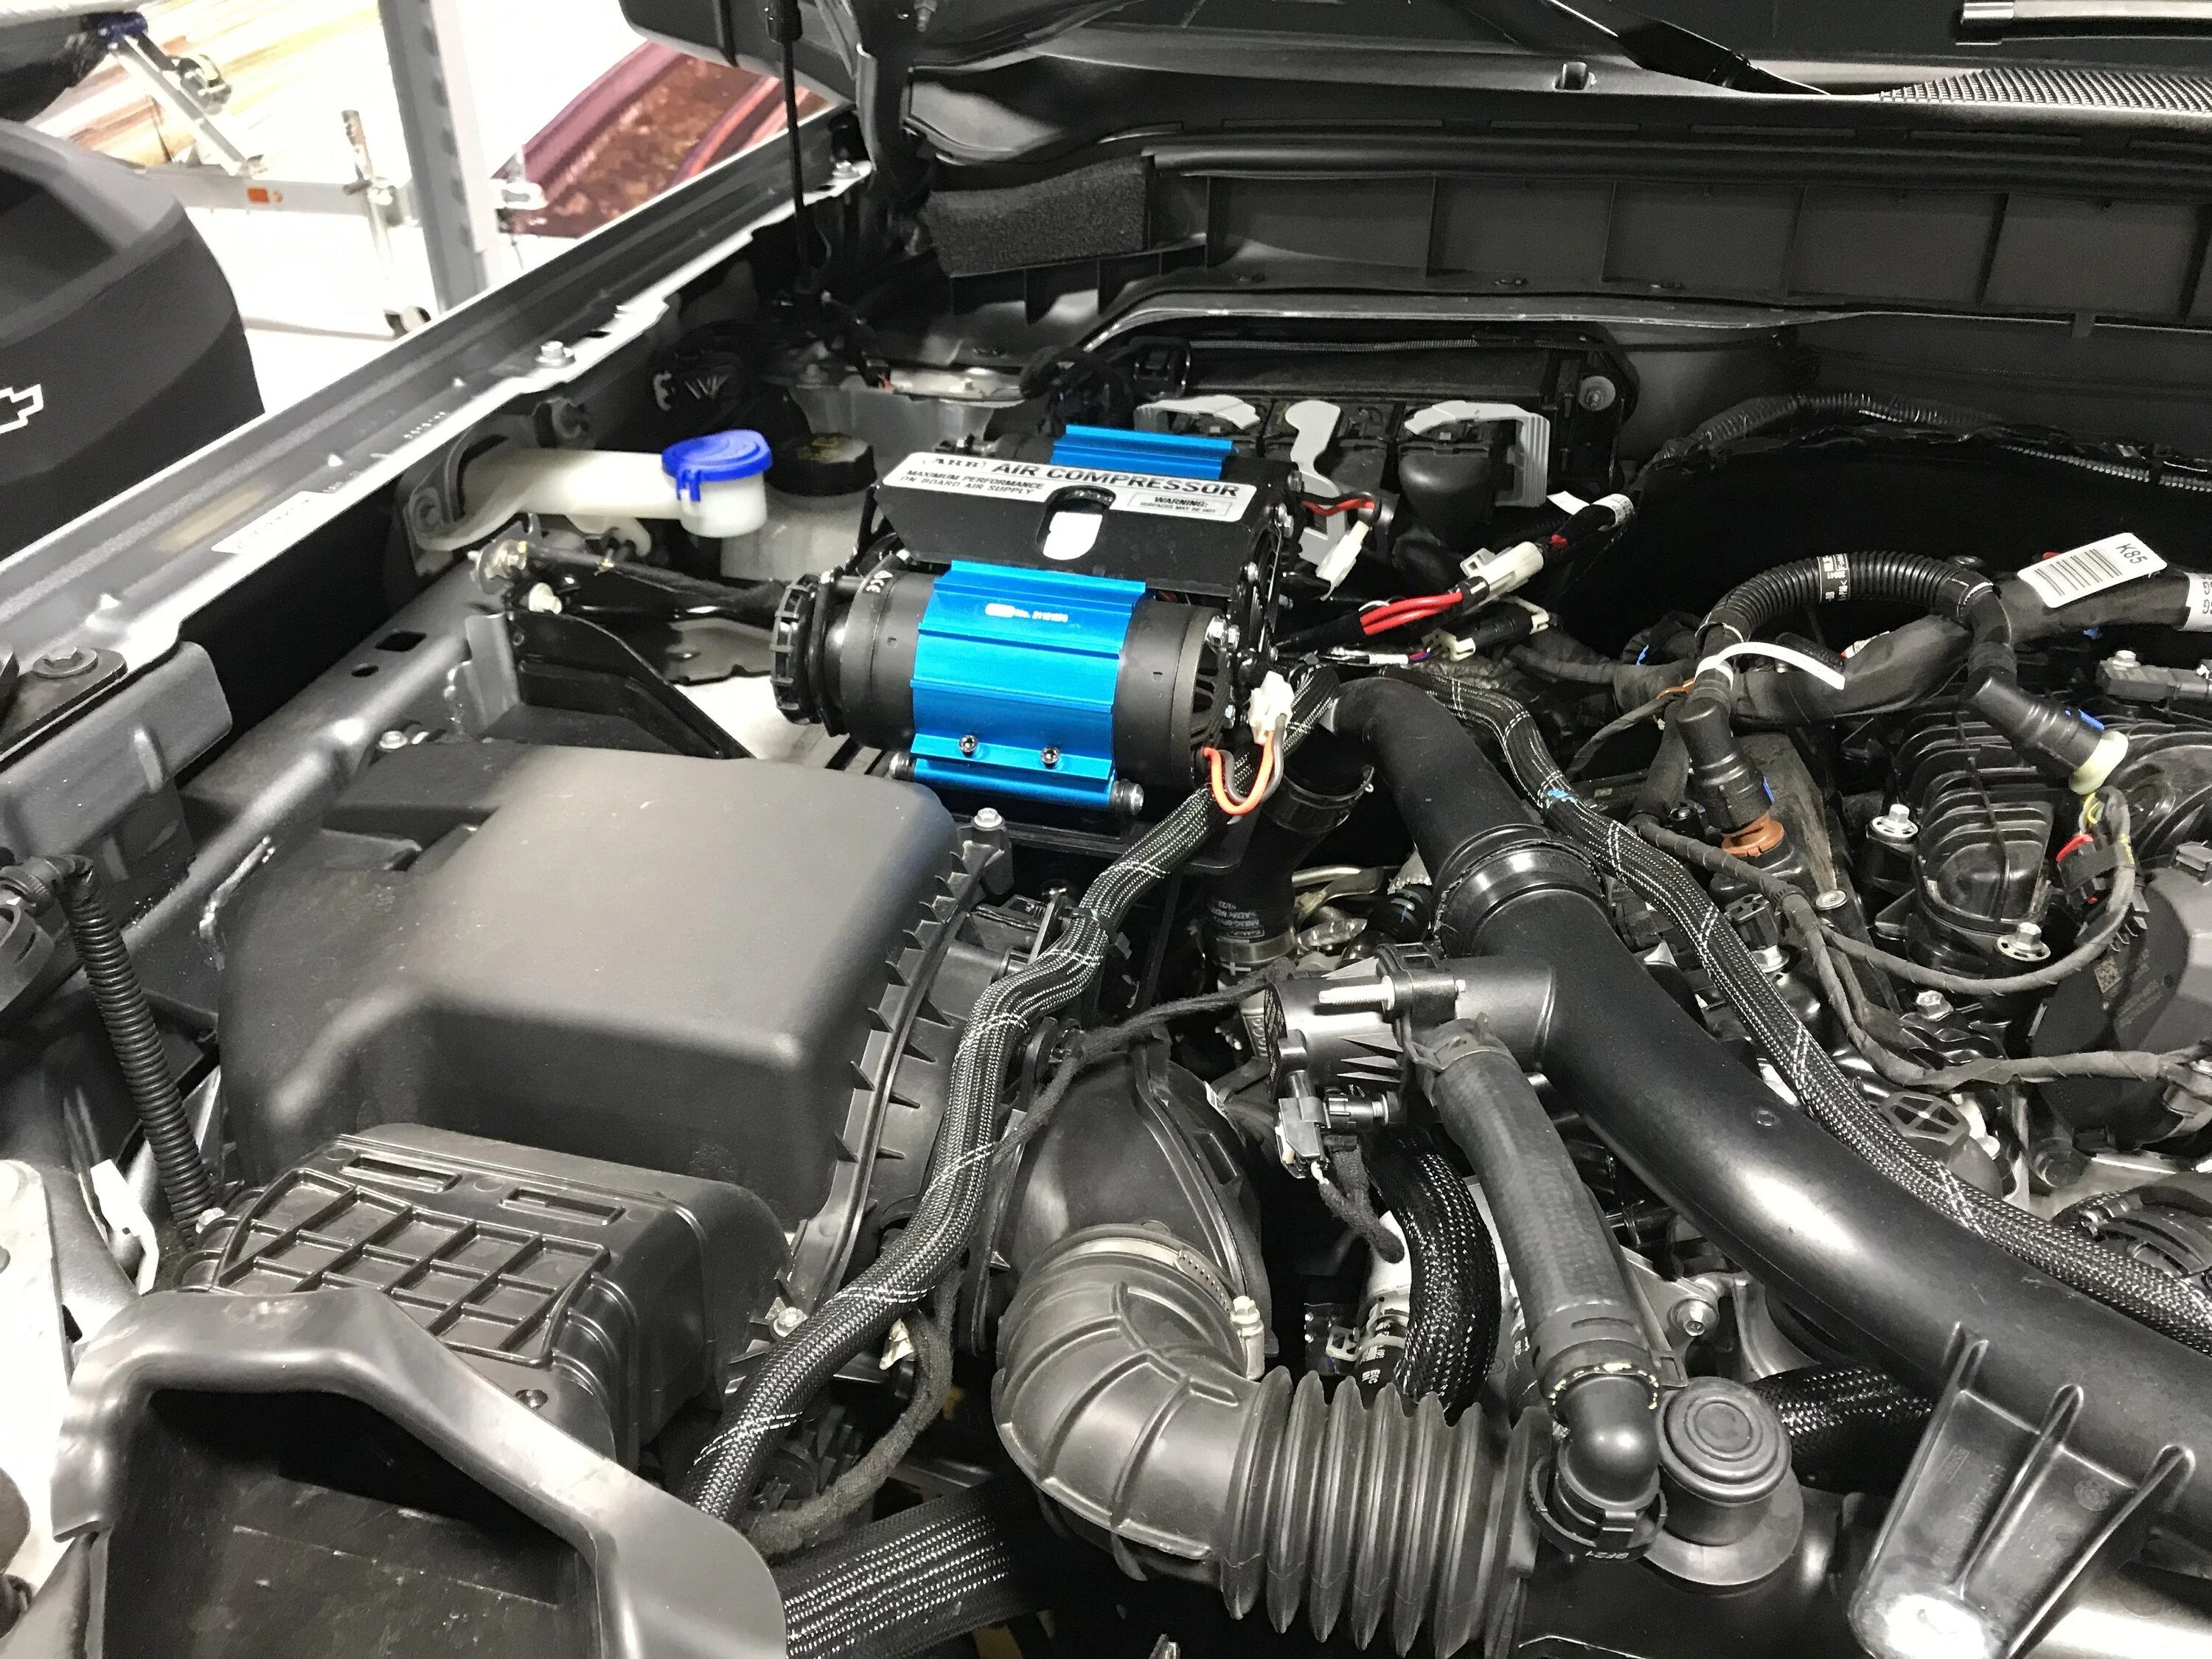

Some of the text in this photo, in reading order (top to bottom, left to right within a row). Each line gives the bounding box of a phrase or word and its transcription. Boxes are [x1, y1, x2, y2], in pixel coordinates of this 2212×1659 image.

[907, 470, 1046, 490] MAXIMUM PERFORMANCE
[922, 478, 961, 487] BOARD
[987, 484, 1035, 495] SUPPLY
[992, 463, 1040, 477] AIR
[1046, 467, 1240, 497] COMPRESSOR
[2115, 543, 2148, 564] K85
